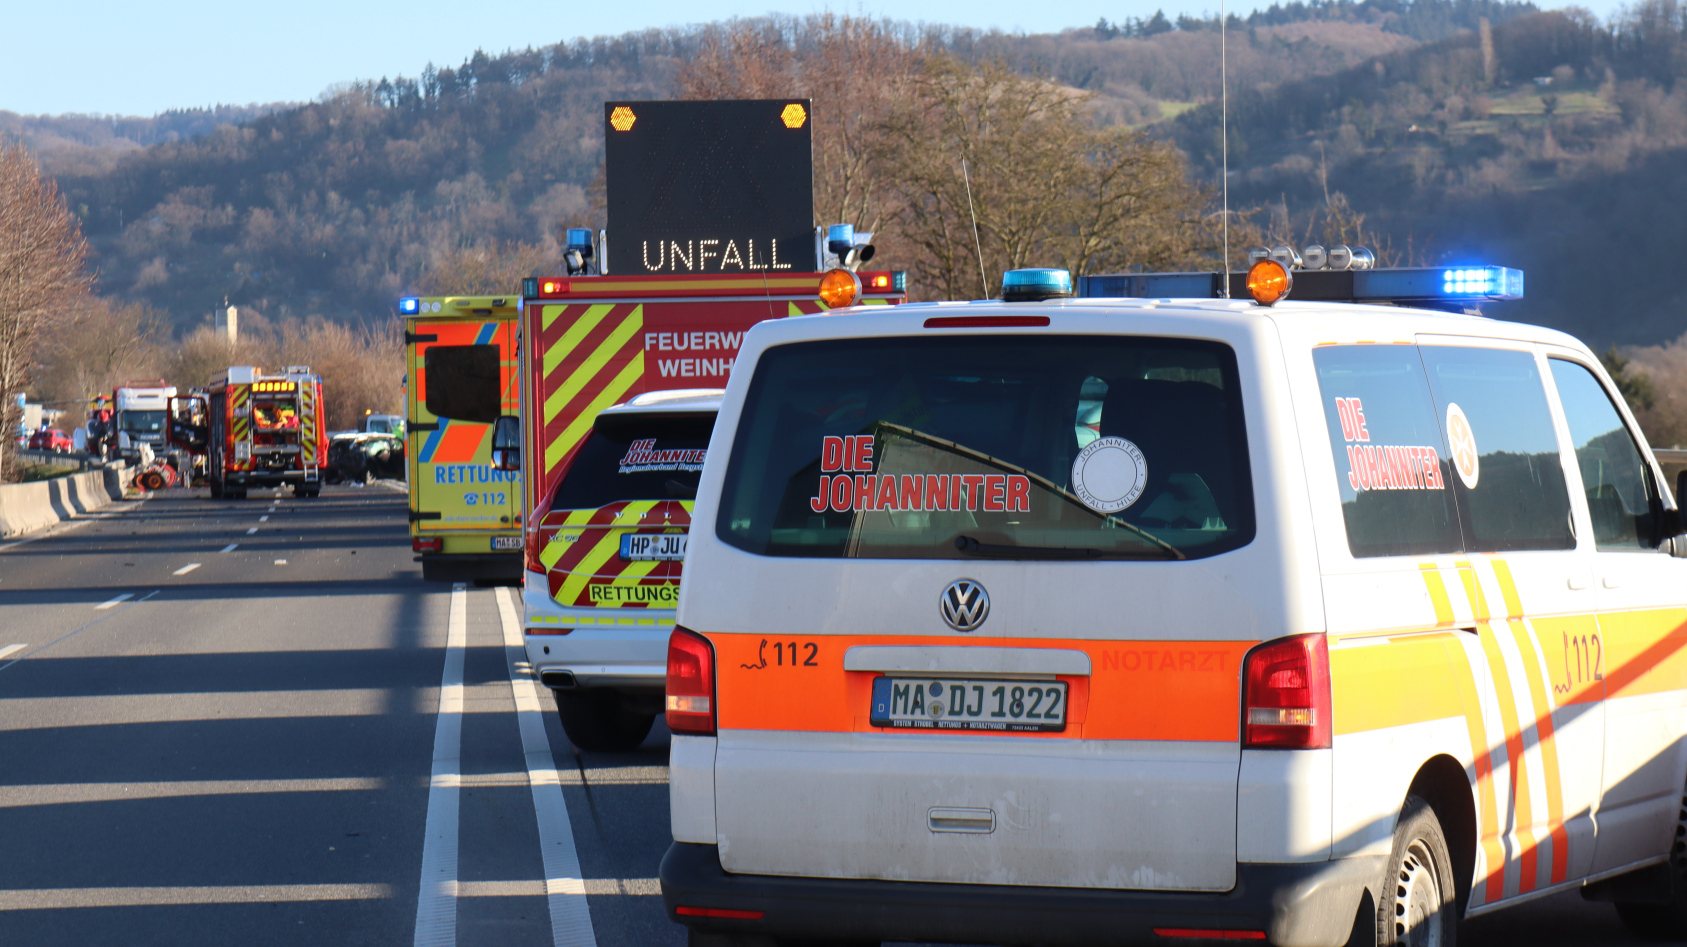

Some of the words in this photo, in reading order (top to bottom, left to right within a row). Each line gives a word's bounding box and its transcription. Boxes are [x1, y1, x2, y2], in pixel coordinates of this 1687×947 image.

[643, 238, 792, 271] UNFALL
[657, 358, 734, 377] WEINH
[1335, 397, 1370, 442] DIE
[629, 438, 656, 451] DIE
[820, 435, 875, 472] DIE
[1347, 444, 1445, 491] JOHANNITER
[482, 491, 506, 505] 112
[810, 473, 1032, 513] JOHANNITER
[496, 537, 506, 547] MA
[630, 537, 650, 554] HP
[660, 537, 680, 554] JU
[772, 642, 819, 668] 112
[1101, 649, 1230, 673] NOTARZT
[1573, 633, 1603, 683] 112
[891, 683, 926, 716] MA
[990, 686, 1062, 719] 1822
[893, 719, 912, 727] SYSTEM
